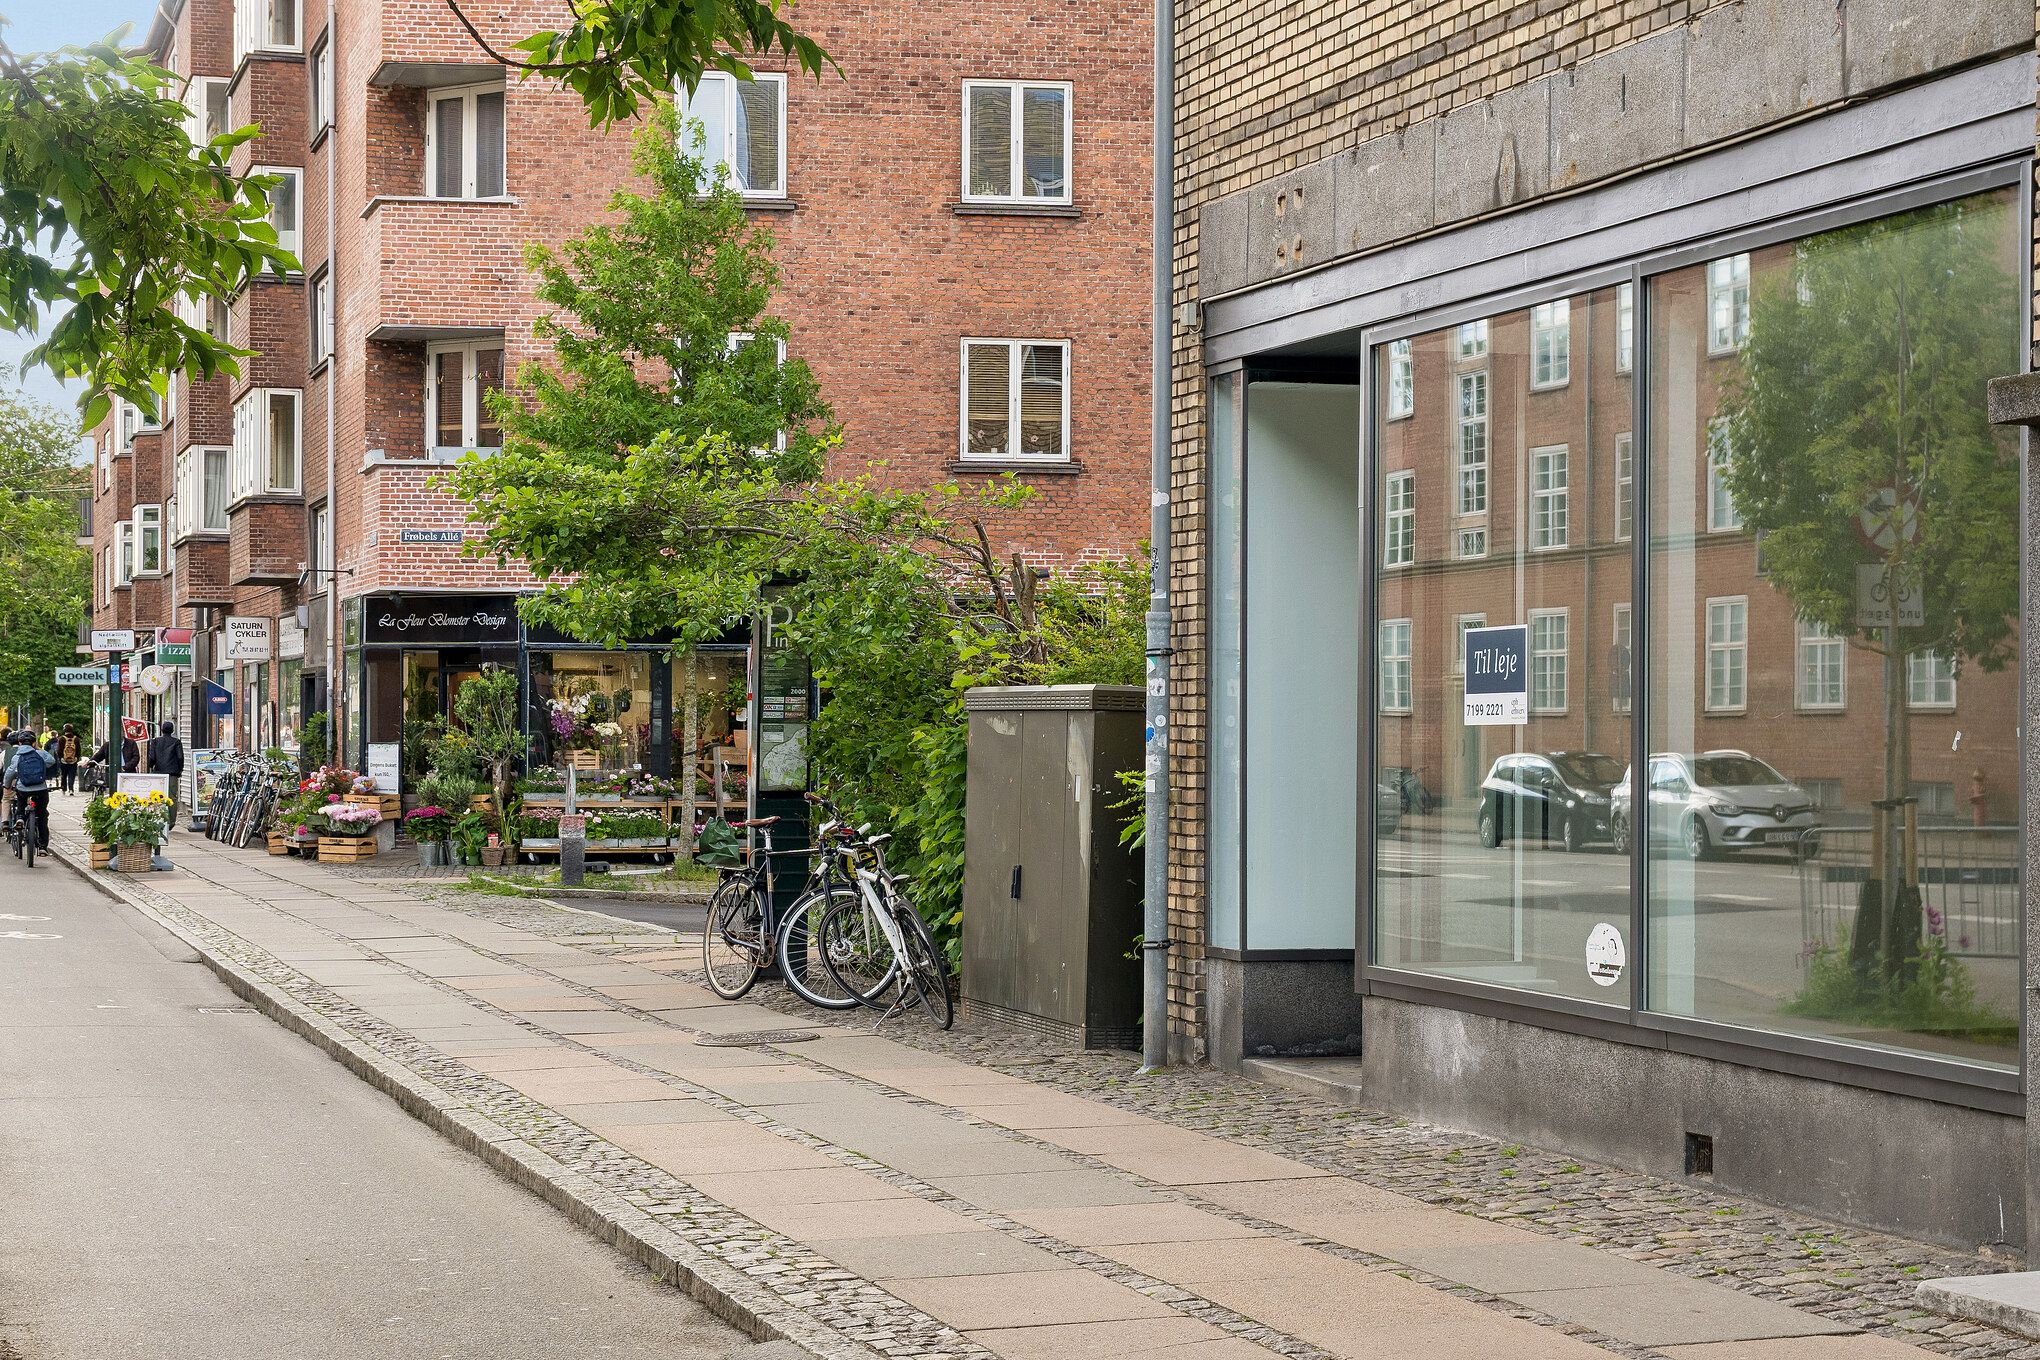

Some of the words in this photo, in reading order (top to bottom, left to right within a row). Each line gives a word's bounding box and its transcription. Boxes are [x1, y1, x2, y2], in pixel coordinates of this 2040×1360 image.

[404, 531, 438, 541] Frøbels
[440, 531, 459, 541] Allé
[230, 622, 263, 630] SATURN
[378, 613, 396, 627] La
[428, 612, 471, 627] Blomster
[472, 612, 507, 630] Design
[235, 630, 267, 638] CYKLER
[1474, 648, 1491, 675] Til
[1494, 647, 1518, 681] leje
[58, 671, 105, 683] apotek
[1466, 704, 1484, 717] 7199
[1486, 703, 1504, 716] 2221
